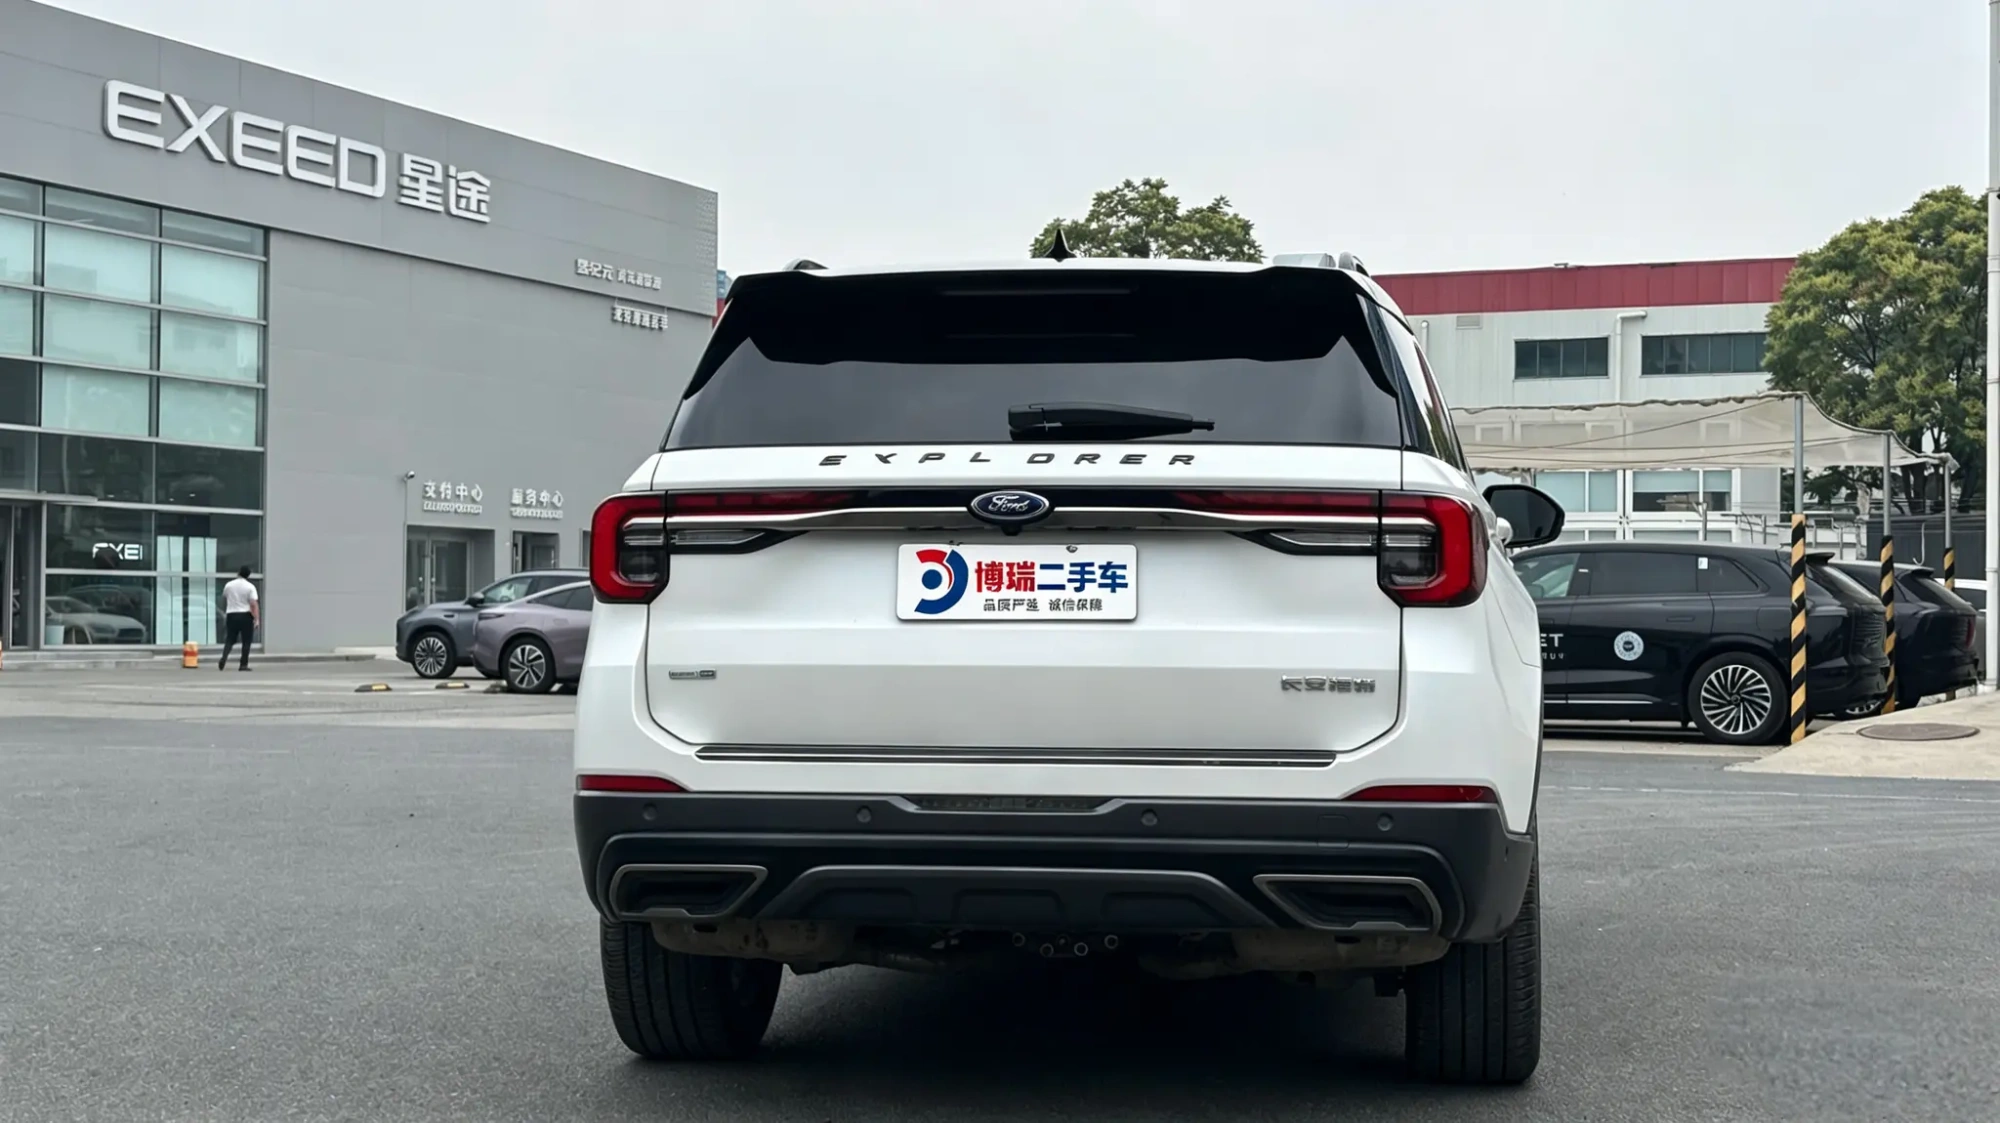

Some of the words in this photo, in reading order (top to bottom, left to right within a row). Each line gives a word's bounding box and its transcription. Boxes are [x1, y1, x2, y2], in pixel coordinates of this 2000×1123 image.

[104, 80, 385, 198] EXEED
[397, 152, 491, 223] 星途
[818, 451, 1197, 466] EXPLORER
[988, 495, 1030, 512] Ford
[974, 560, 1129, 594] 博瑞二手车
